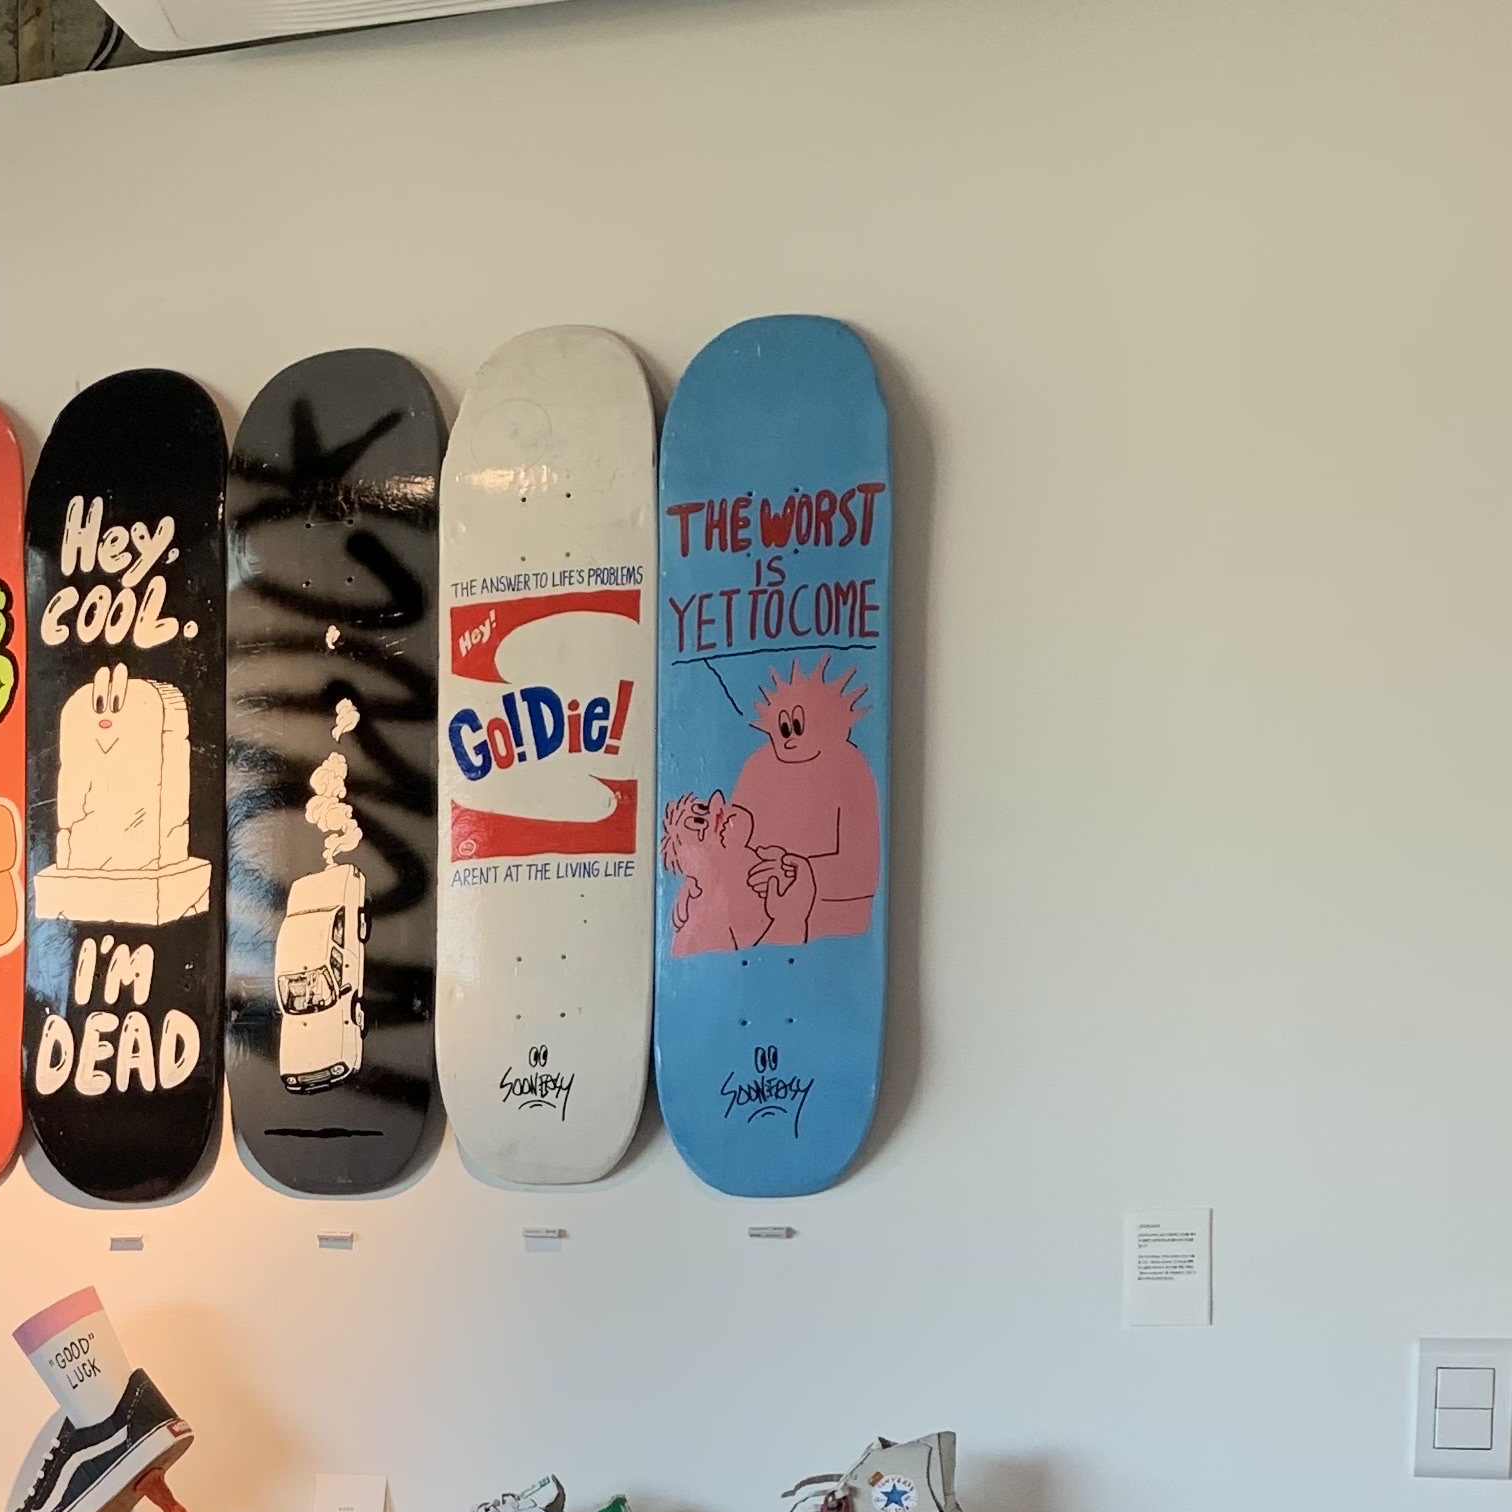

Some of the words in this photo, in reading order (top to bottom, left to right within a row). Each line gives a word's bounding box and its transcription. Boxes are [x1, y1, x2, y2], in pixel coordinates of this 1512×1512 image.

[666, 496, 752, 557] THE
[759, 482, 886, 548] WORST
[451, 579, 477, 598] THE
[481, 573, 530, 593] ANSWER
[532, 572, 548, 588] TO
[552, 569, 584, 587] LIFE'S
[587, 566, 643, 586] PROBLEMS
[755, 555, 786, 587] IS
[458, 609, 497, 656] Hey!
[669, 588, 741, 653] YET
[748, 588, 784, 640] TO
[789, 578, 879, 638] COME
[451, 864, 501, 887] AREN'T
[504, 863, 522, 883] AT
[526, 862, 553, 881] THE
[556, 860, 600, 879] LIVING
[604, 860, 635, 877] LIFE
[74, 935, 154, 1005] I'M
[35, 1009, 200, 1096] DEAD
[66, 1358, 101, 1389] LUCK
